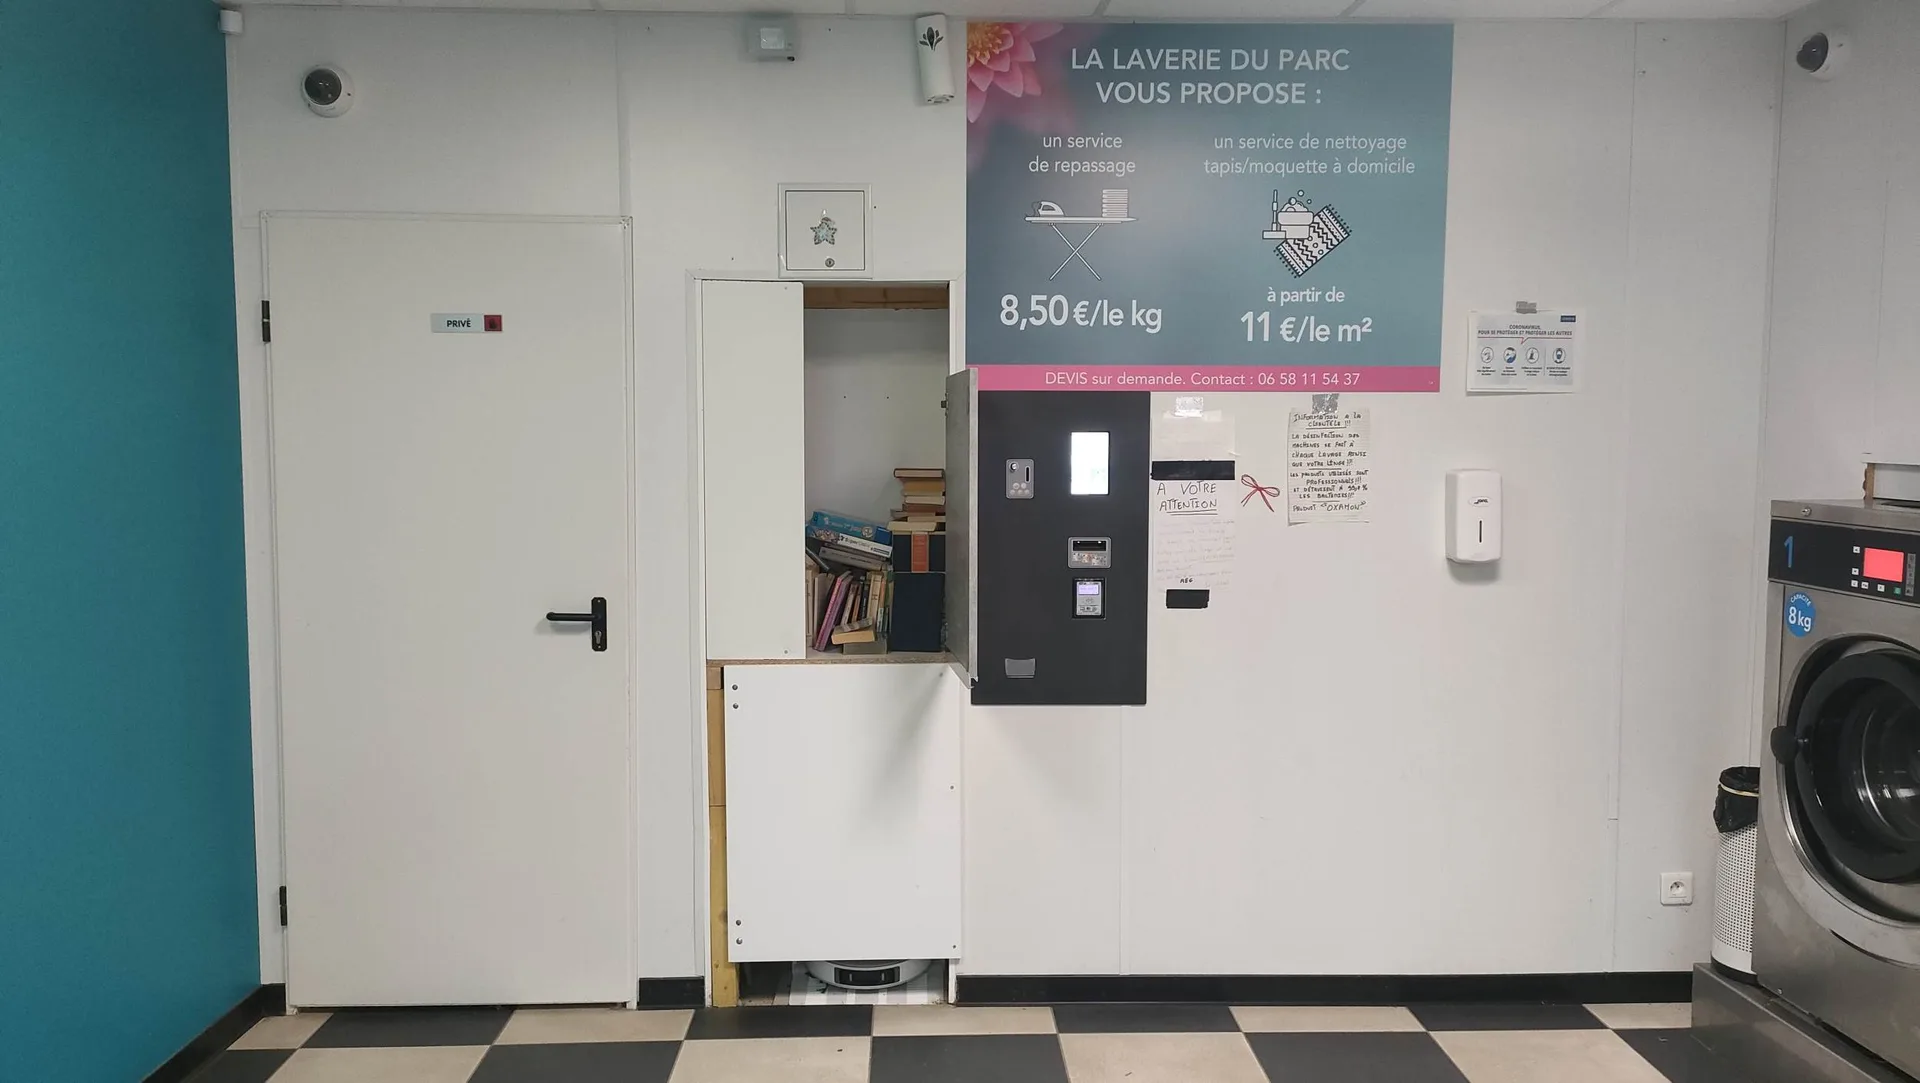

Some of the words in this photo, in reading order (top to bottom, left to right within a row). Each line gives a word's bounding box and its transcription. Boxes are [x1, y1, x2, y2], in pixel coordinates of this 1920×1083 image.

[1071, 48, 1103, 70] LA
[1113, 48, 1221, 71] LAVERIE
[1230, 48, 1269, 71] DU
[1279, 48, 1350, 71] PARC
[1095, 81, 1171, 104] VOUS
[1180, 82, 1306, 105] PROPOSE
[1042, 136, 1062, 149] un
[1067, 132, 1123, 149] service
[1214, 137, 1233, 149] un
[1238, 133, 1294, 150] service
[1299, 133, 1321, 150] de
[1325, 134, 1407, 155] nettoyage
[1028, 157, 1050, 174] de
[1054, 159, 1137, 177] repassage
[1203, 157, 1328, 179] tapis/moquette
[1332, 157, 1343, 174] à
[1347, 157, 1416, 174] domicile
[1266, 287, 1277, 303] à
[1280, 287, 1322, 307] partir
[1324, 286, 1346, 303] de
[446, 318, 472, 328] PRIVÉ
[999, 294, 1069, 332] 8,50
[1072, 299, 1124, 328] €/le
[1131, 299, 1163, 333] kg
[1240, 312, 1270, 342] 11
[1279, 316, 1331, 343] €/le
[1337, 318, 1373, 342] m²
[1045, 372, 1088, 386] DEVIS
[1091, 375, 1113, 386] sur
[1116, 372, 1187, 386] demande.
[1190, 372, 1246, 386] Contact
[1257, 372, 1276, 386] 06
[1280, 372, 1297, 386] 58
[1301, 372, 1316, 386] 11
[1322, 372, 1340, 386] 54
[1343, 372, 1361, 386] 37
[1156, 482, 1167, 496] A
[1180, 480, 1217, 496] VOTRE
[1159, 497, 1218, 512] ATTENTION
[1784, 535, 1794, 568] 1
[1788, 606, 1797, 625] 8
[1797, 610, 1812, 632] kg
